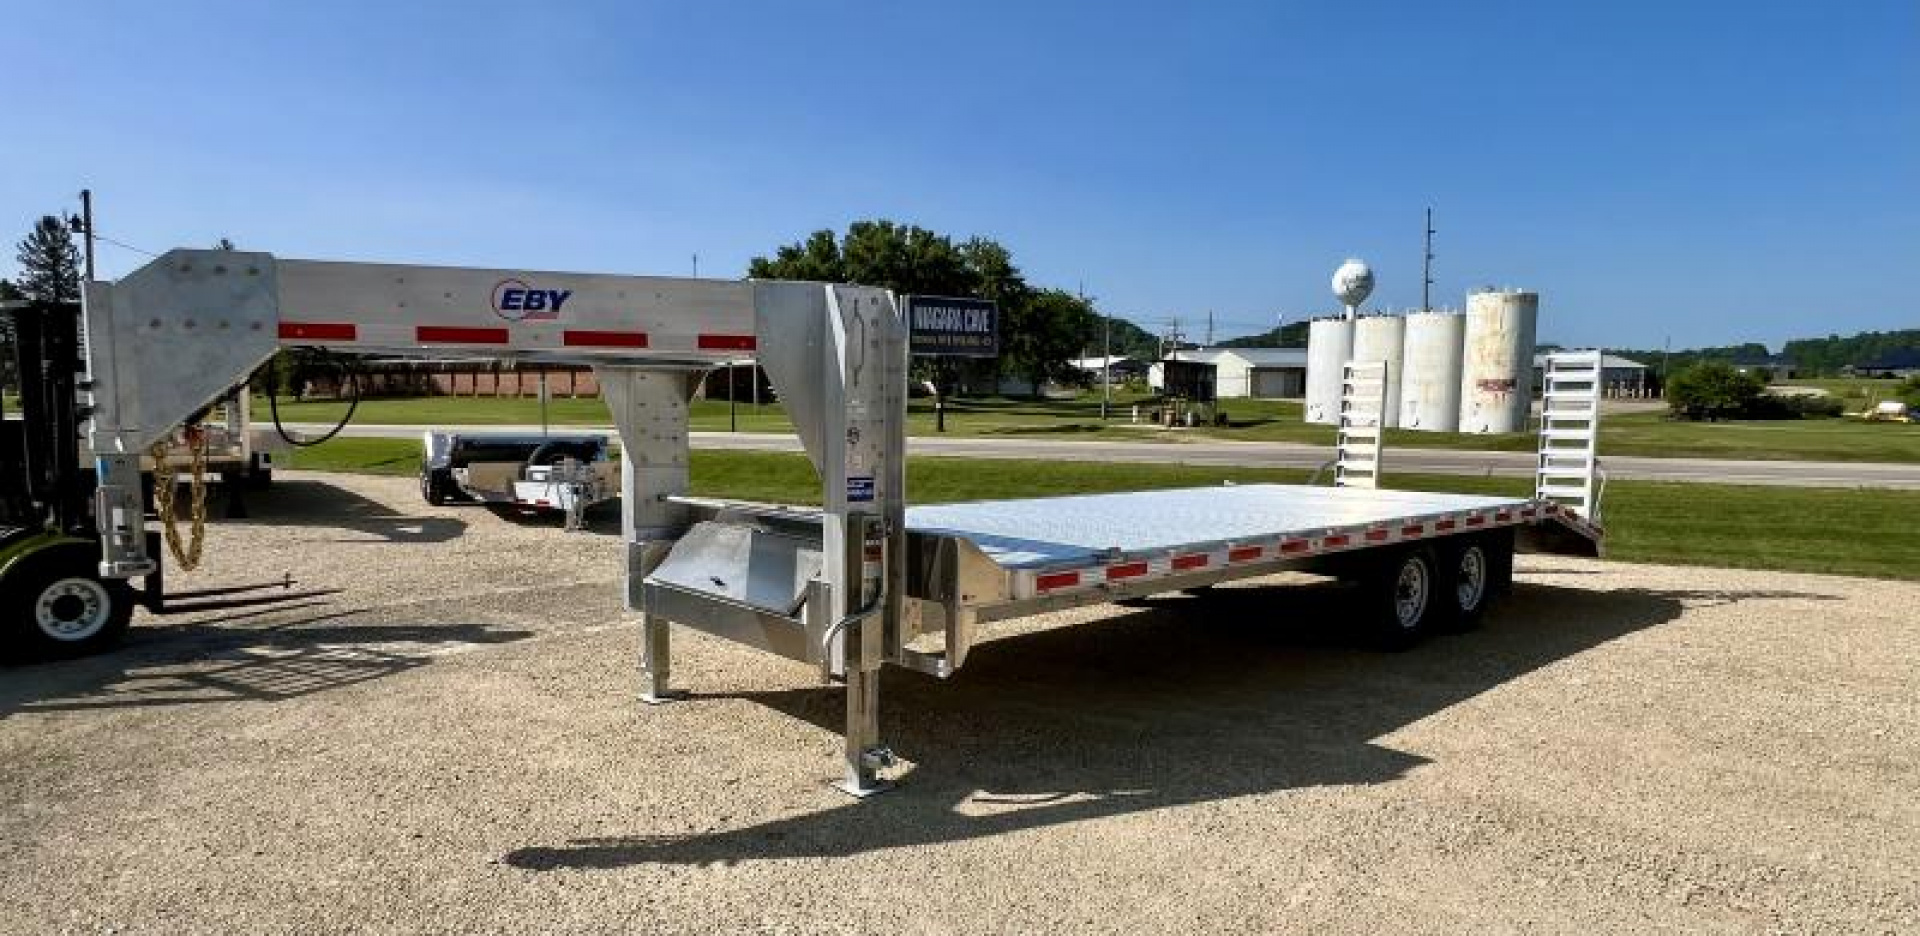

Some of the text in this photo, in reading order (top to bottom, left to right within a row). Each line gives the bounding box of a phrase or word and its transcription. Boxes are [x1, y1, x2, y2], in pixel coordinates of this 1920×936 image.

[501, 289, 573, 312] EBY
[914, 306, 990, 332] NIAGARA CAVE
